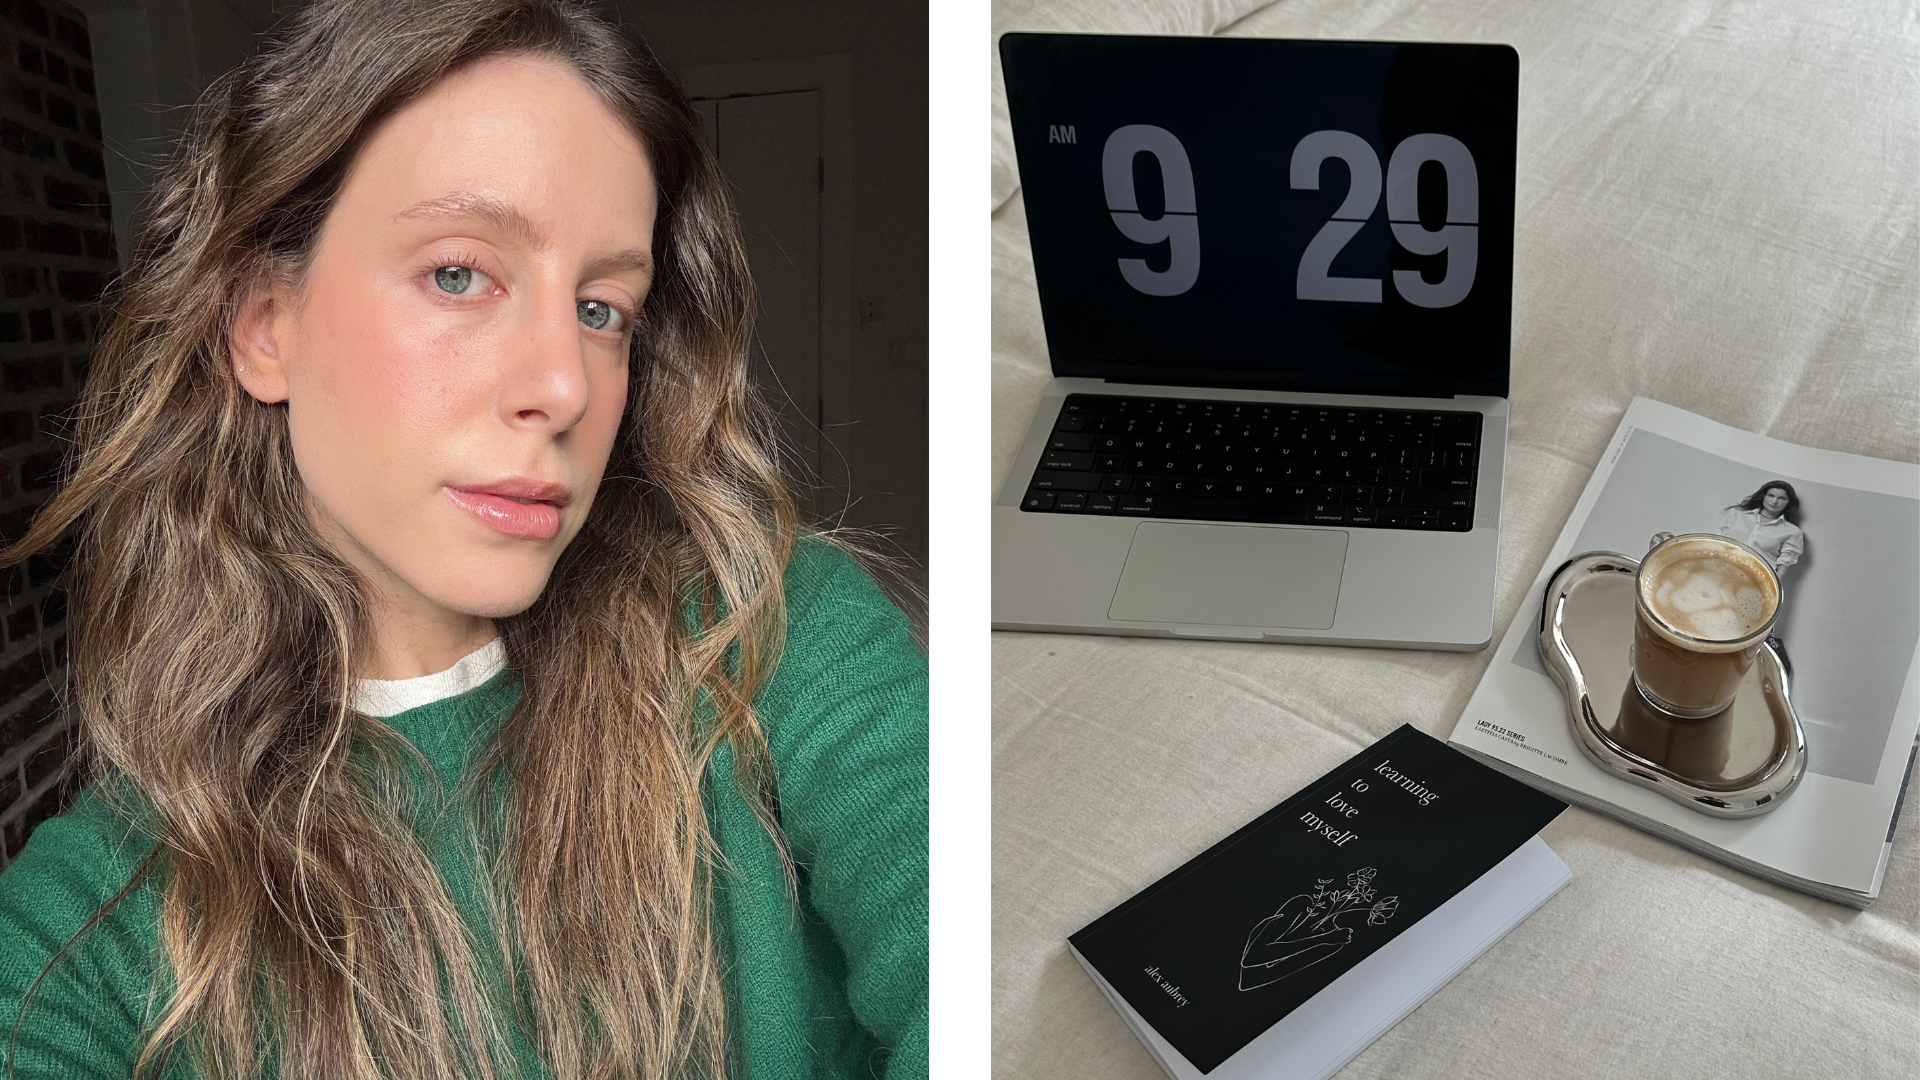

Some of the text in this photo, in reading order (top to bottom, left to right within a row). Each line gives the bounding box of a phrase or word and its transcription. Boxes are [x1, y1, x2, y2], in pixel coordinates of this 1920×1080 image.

[1048, 124, 1078, 145] AM
[1101, 123, 1479, 309] 9 29
[1475, 726, 1499, 737] LAETITIA
[1520, 743, 1543, 755] BRIGITTE
[1506, 730, 1526, 742] SERIES
[1350, 777, 1370, 793] to
[1373, 760, 1440, 806] learning
[1325, 791, 1359, 819] love
[1299, 811, 1359, 848] myself
[1144, 965, 1190, 1008] alex aubrey
